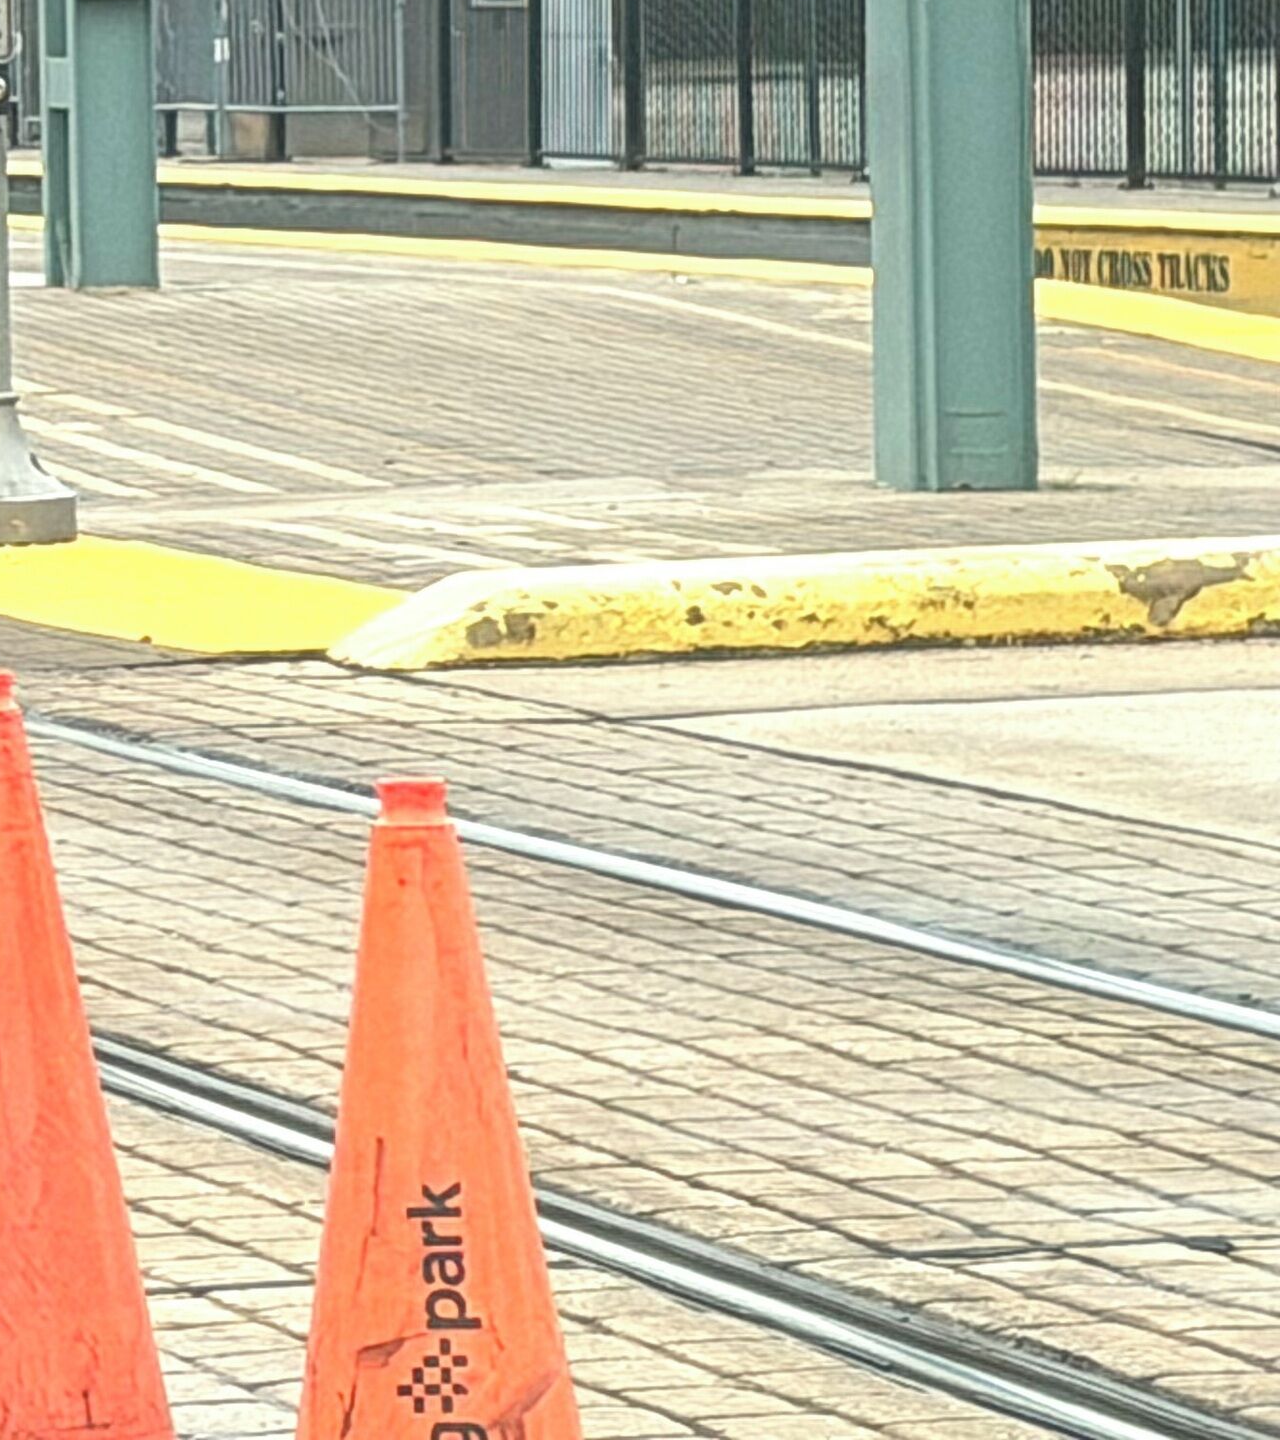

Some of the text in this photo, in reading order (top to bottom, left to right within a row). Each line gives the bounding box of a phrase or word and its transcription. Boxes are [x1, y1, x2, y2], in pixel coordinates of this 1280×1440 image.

[1059, 248, 1093, 283] NOT
[1095, 249, 1152, 288] CROSS
[1156, 252, 1231, 293] TRACKS
[405, 1181, 483, 1331] park
